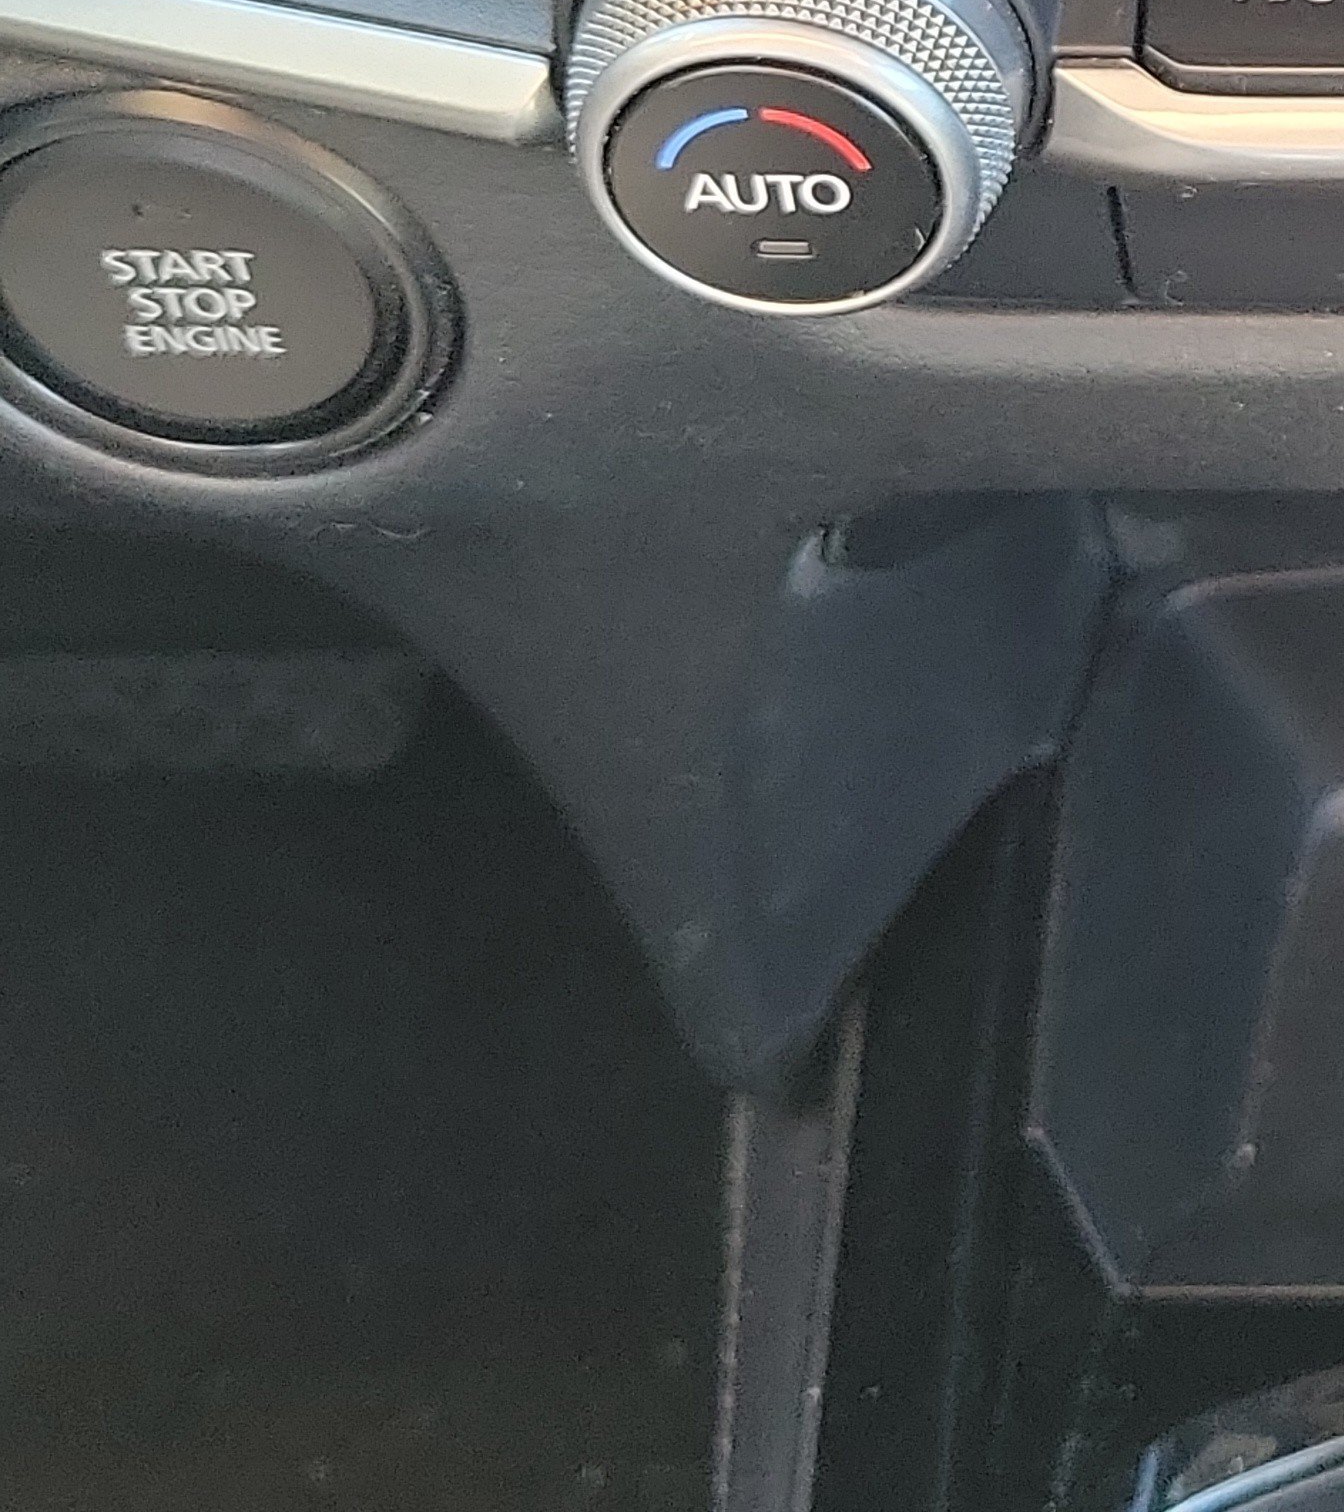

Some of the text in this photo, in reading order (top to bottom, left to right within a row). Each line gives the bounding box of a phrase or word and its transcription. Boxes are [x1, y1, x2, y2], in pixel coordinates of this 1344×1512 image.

[685, 172, 852, 216] AUTO
[102, 250, 255, 285] START
[128, 287, 257, 322] STOP
[124, 323, 286, 357] ENGINE
